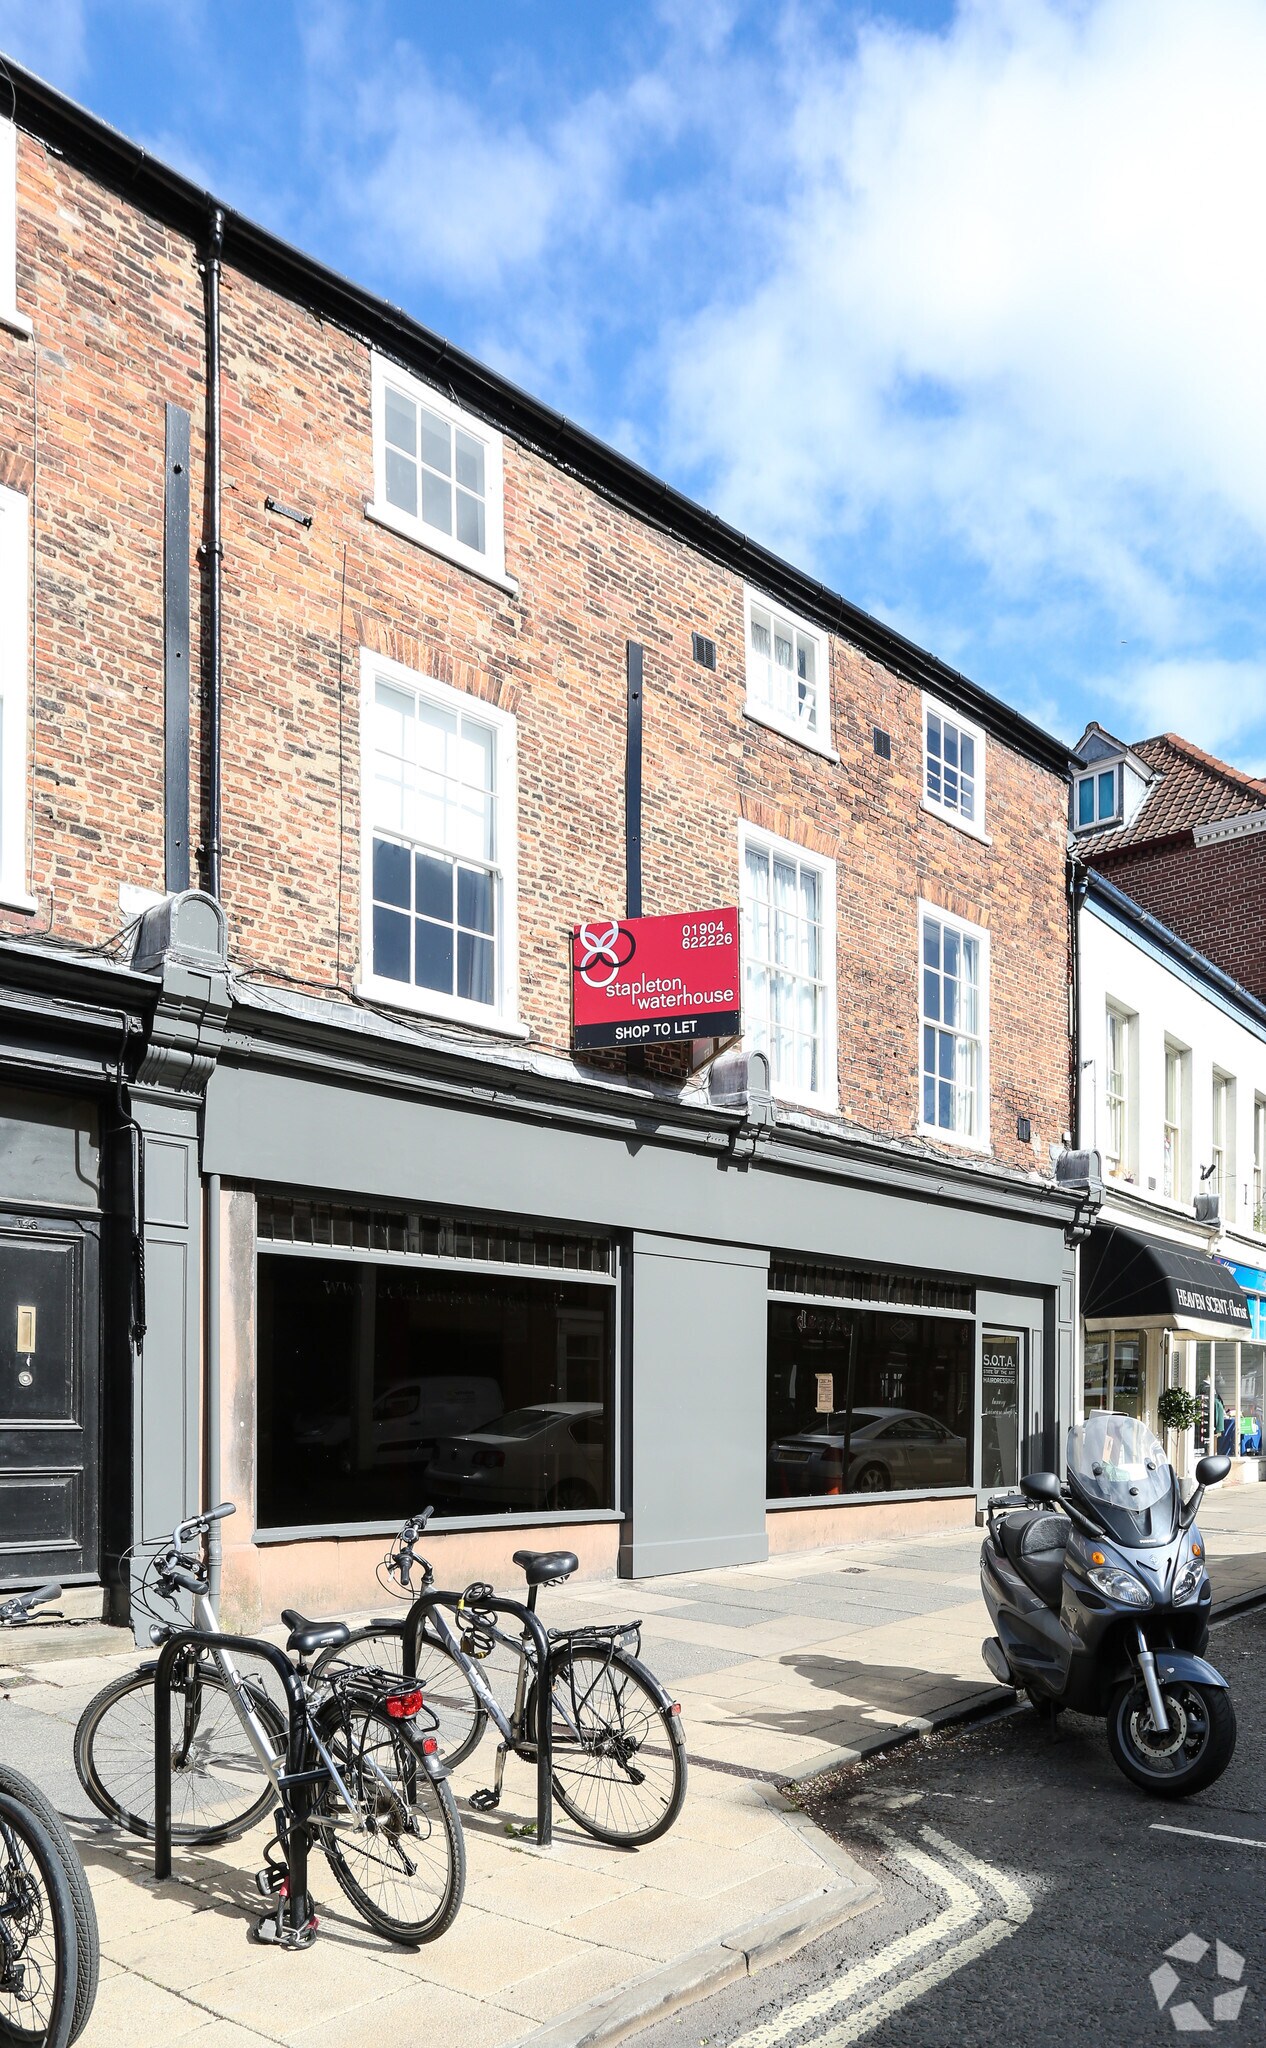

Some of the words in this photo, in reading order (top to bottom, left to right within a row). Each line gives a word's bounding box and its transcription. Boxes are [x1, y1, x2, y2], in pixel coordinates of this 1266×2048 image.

[682, 921, 725, 937] 01904
[682, 933, 733, 950] 622226
[605, 972, 682, 1005] stapleton
[637, 983, 734, 1010] waterhouse
[615, 1024, 650, 1040] SHOP
[653, 1022, 671, 1036] TO
[674, 1020, 698, 1034] LET
[1176, 1288, 1206, 1310] HEAVEN
[983, 1354, 1015, 1367] S.O.T.A.
[983, 1377, 1016, 1385] HAIRDRESSING
